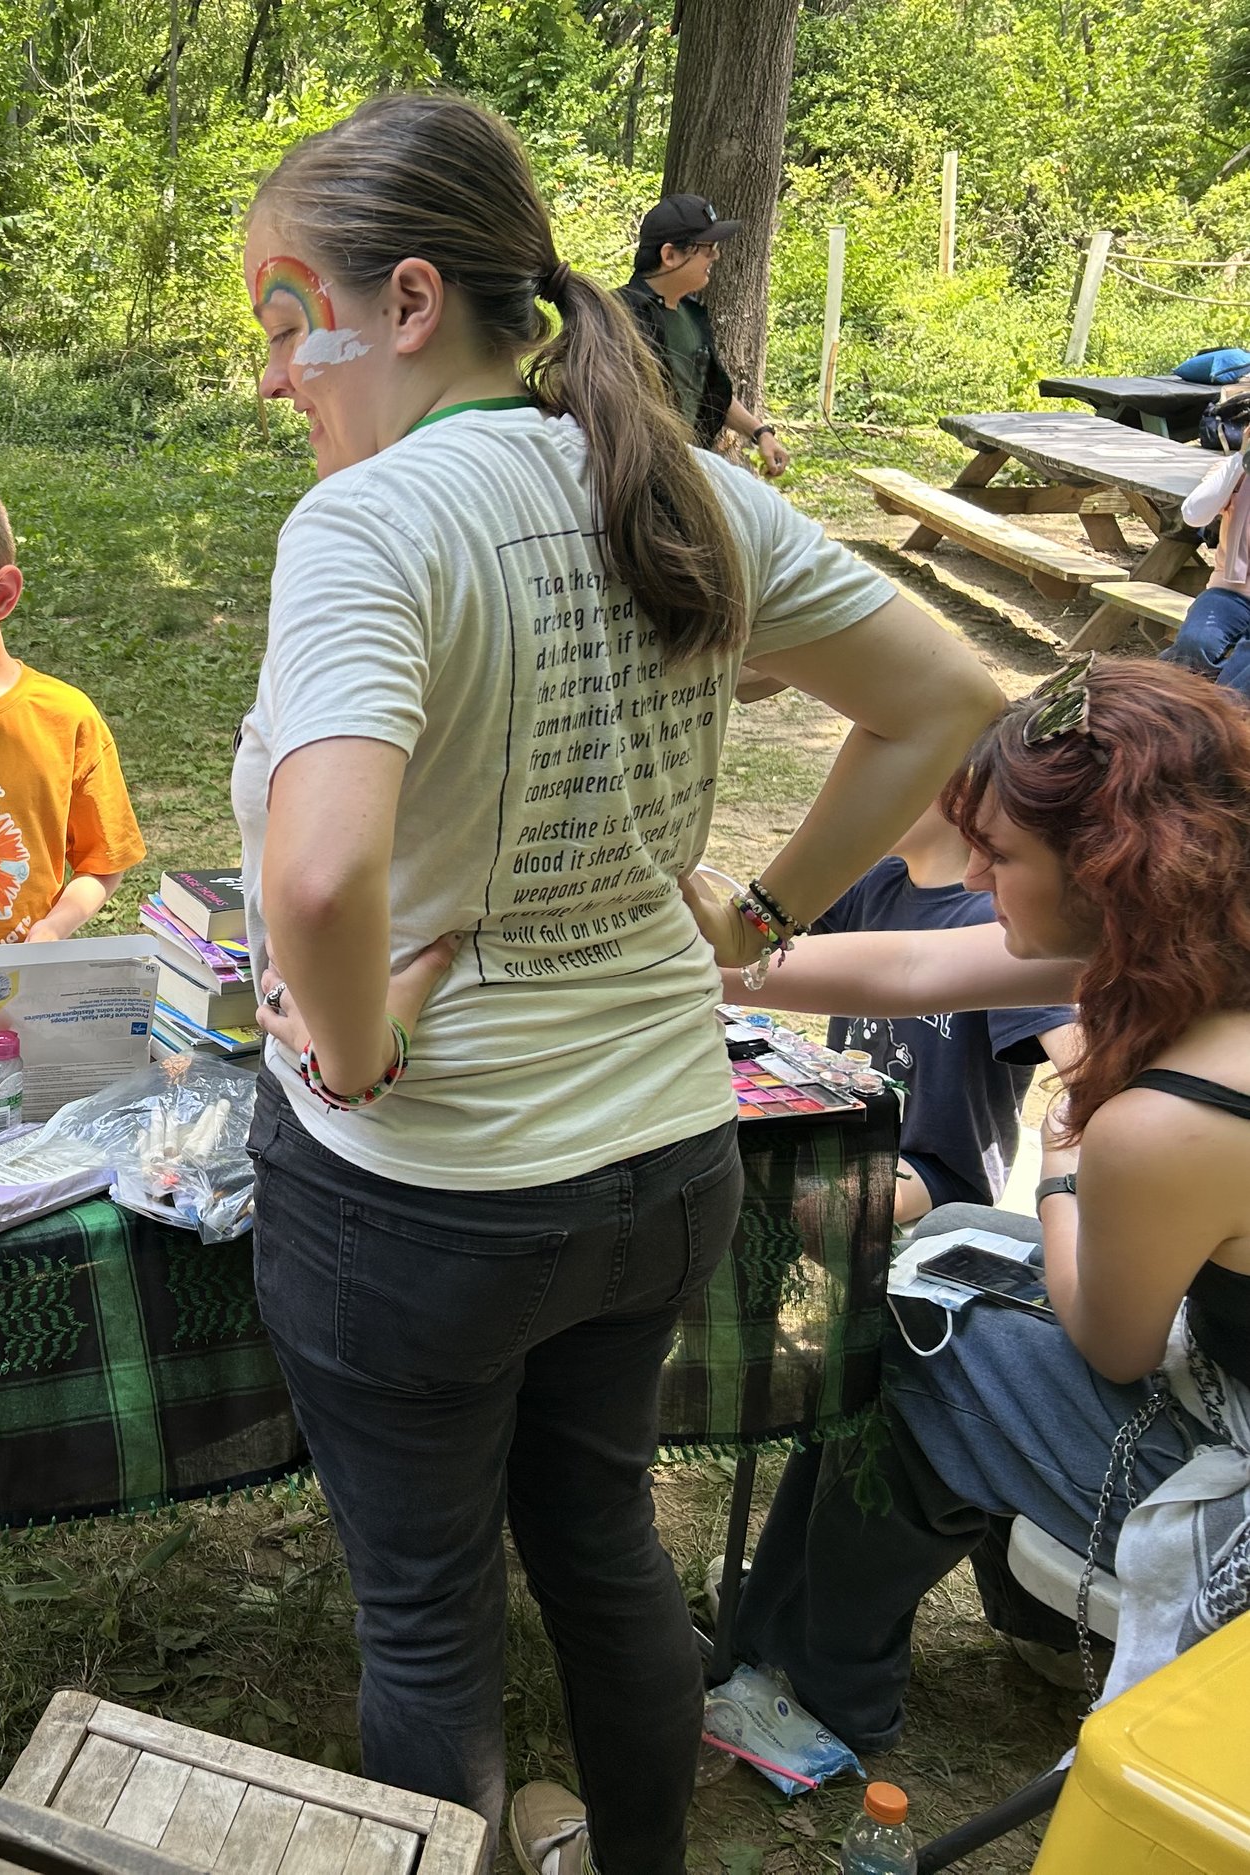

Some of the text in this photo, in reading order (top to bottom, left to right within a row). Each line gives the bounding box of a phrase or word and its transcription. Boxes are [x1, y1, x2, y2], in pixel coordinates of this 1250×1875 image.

[618, 630, 634, 654] if
[631, 690, 668, 718] their
[529, 748, 562, 771] from
[567, 738, 611, 763] their
[517, 817, 598, 845] Palestine
[603, 815, 617, 835] is
[631, 795, 665, 820] orld,
[513, 850, 564, 874] blood
[570, 850, 585, 871] it
[587, 841, 633, 867] sheds
[513, 881, 587, 905] weapons
[591, 869, 624, 893] and
[503, 925, 537, 944] will
[540, 922, 568, 943] fall
[571, 922, 590, 940] on
[592, 917, 608, 935] us
[611, 911, 626, 929] as
[504, 939, 623, 978] SILVIA FEDERICI
[23, 1012, 62, 1021] auriculaires
[50, 1015, 79, 1024] Earloops
[115, 1011, 149, 1020] Procedure
[124, 1006, 149, 1014] Masque
